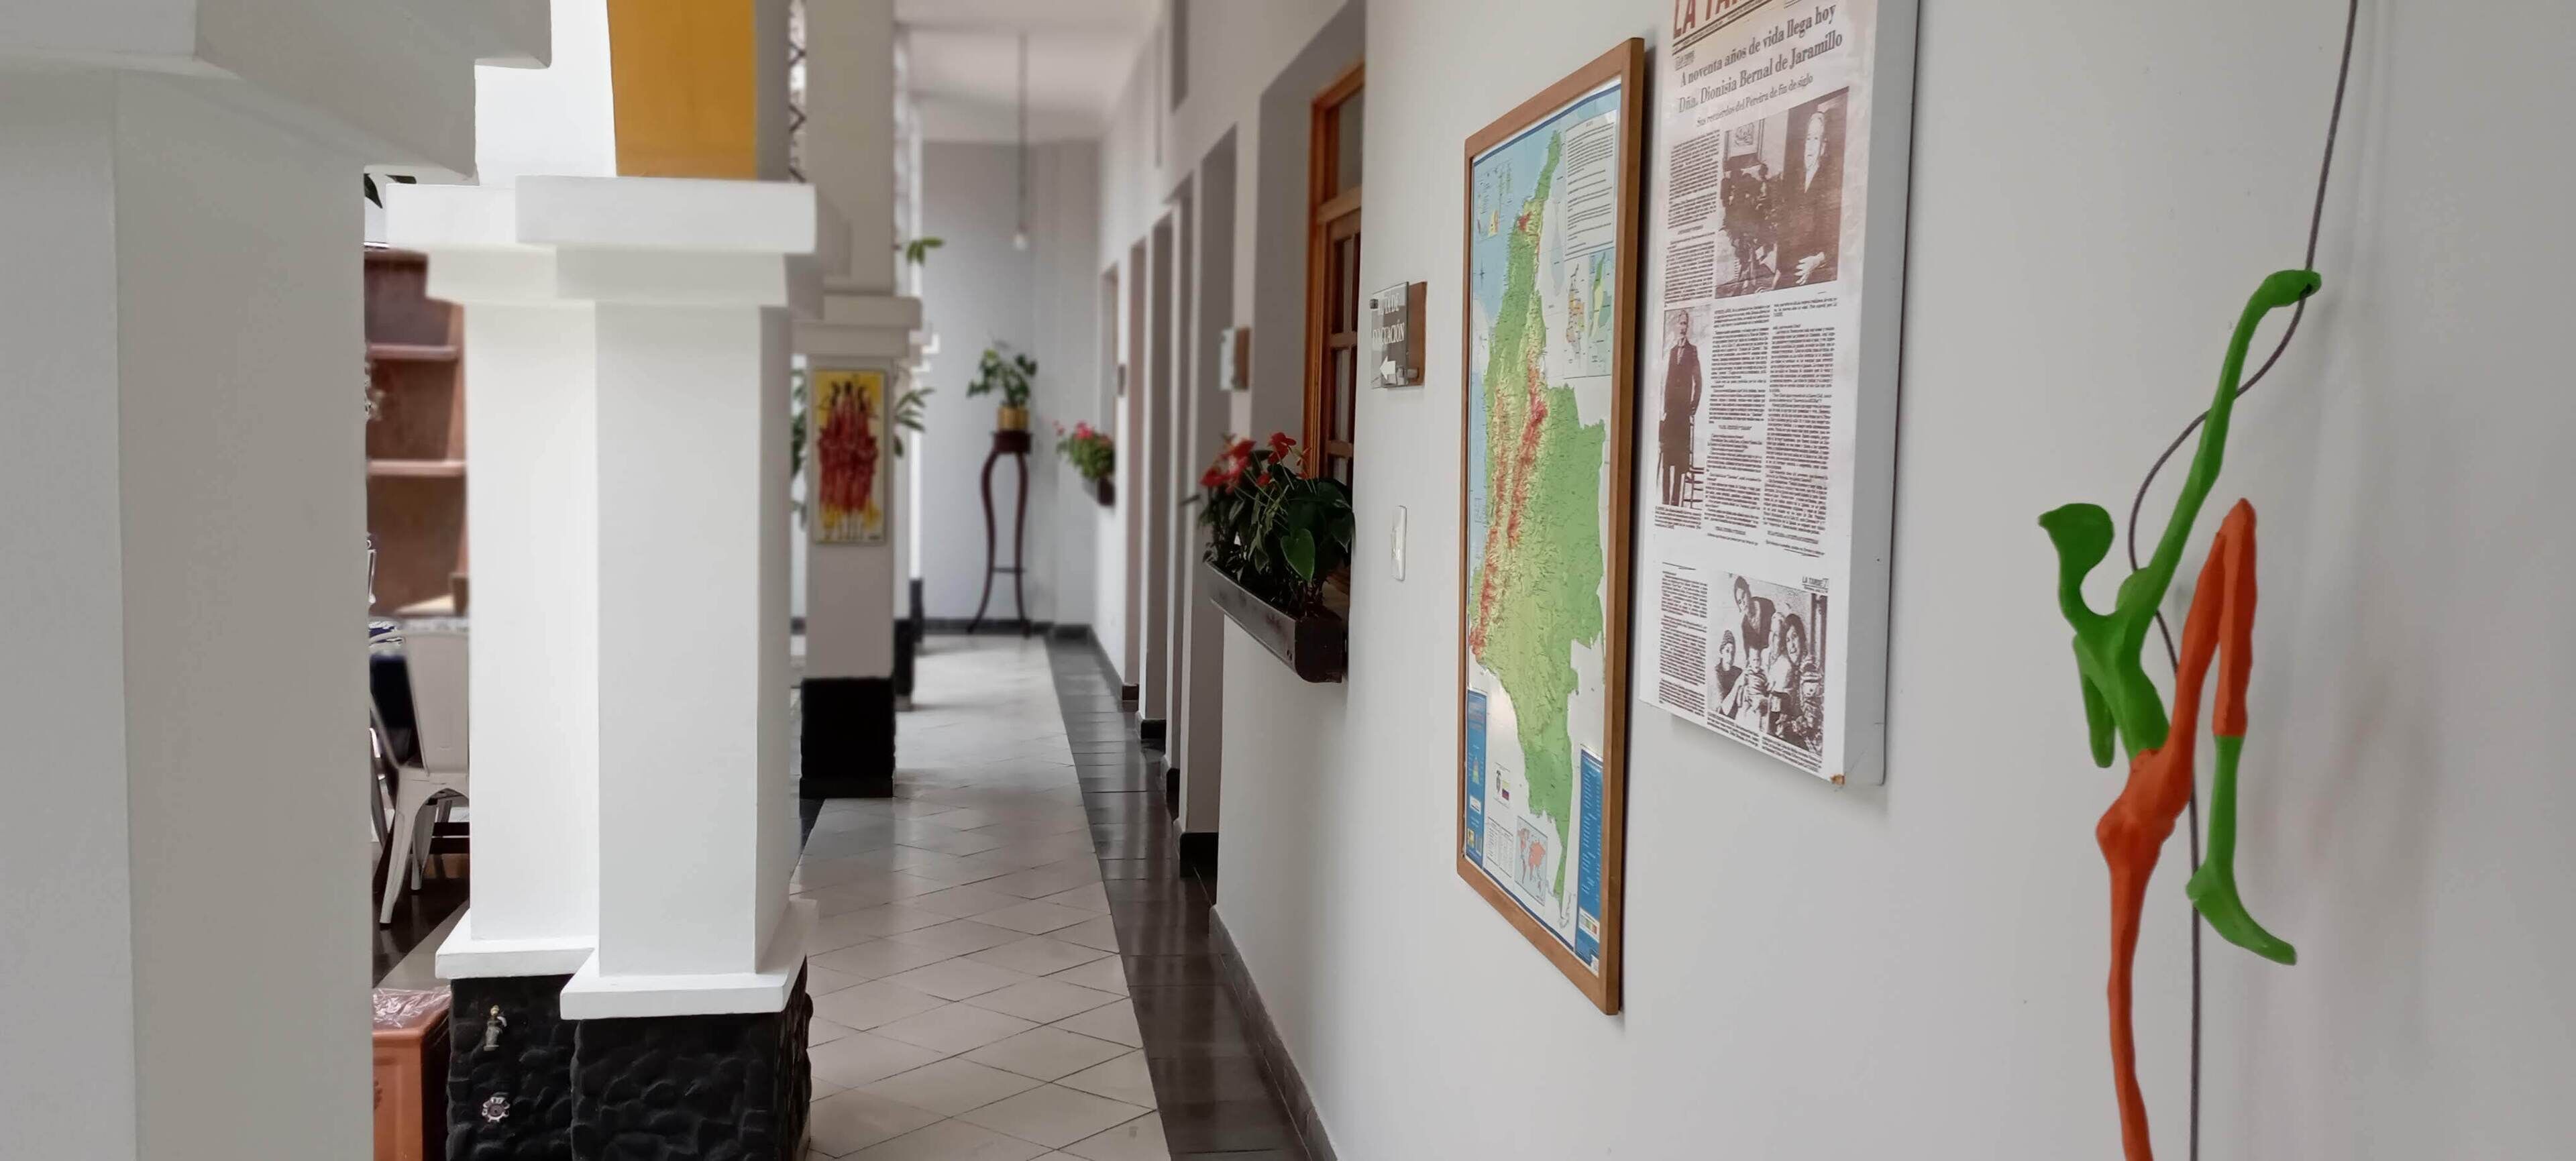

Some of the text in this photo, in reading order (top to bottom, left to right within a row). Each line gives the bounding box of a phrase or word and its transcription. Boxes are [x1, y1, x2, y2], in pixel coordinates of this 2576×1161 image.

[1678, 30, 1843, 114] Dña. Dionisia Bernal de Jaramillo
[1680, 72, 1686, 88] A
[1688, 58, 1723, 84] noventa
[1724, 48, 1747, 67] años
[1748, 37, 1761, 55] de
[1763, 26, 1784, 48] vida
[1786, 19, 1812, 38] llega
[1815, 5, 1836, 25] hoy
[1735, 99, 1745, 113] del
[1746, 93, 1769, 108] Pereira
[1770, 86, 1778, 99] de
[1788, 78, 1797, 91] de
